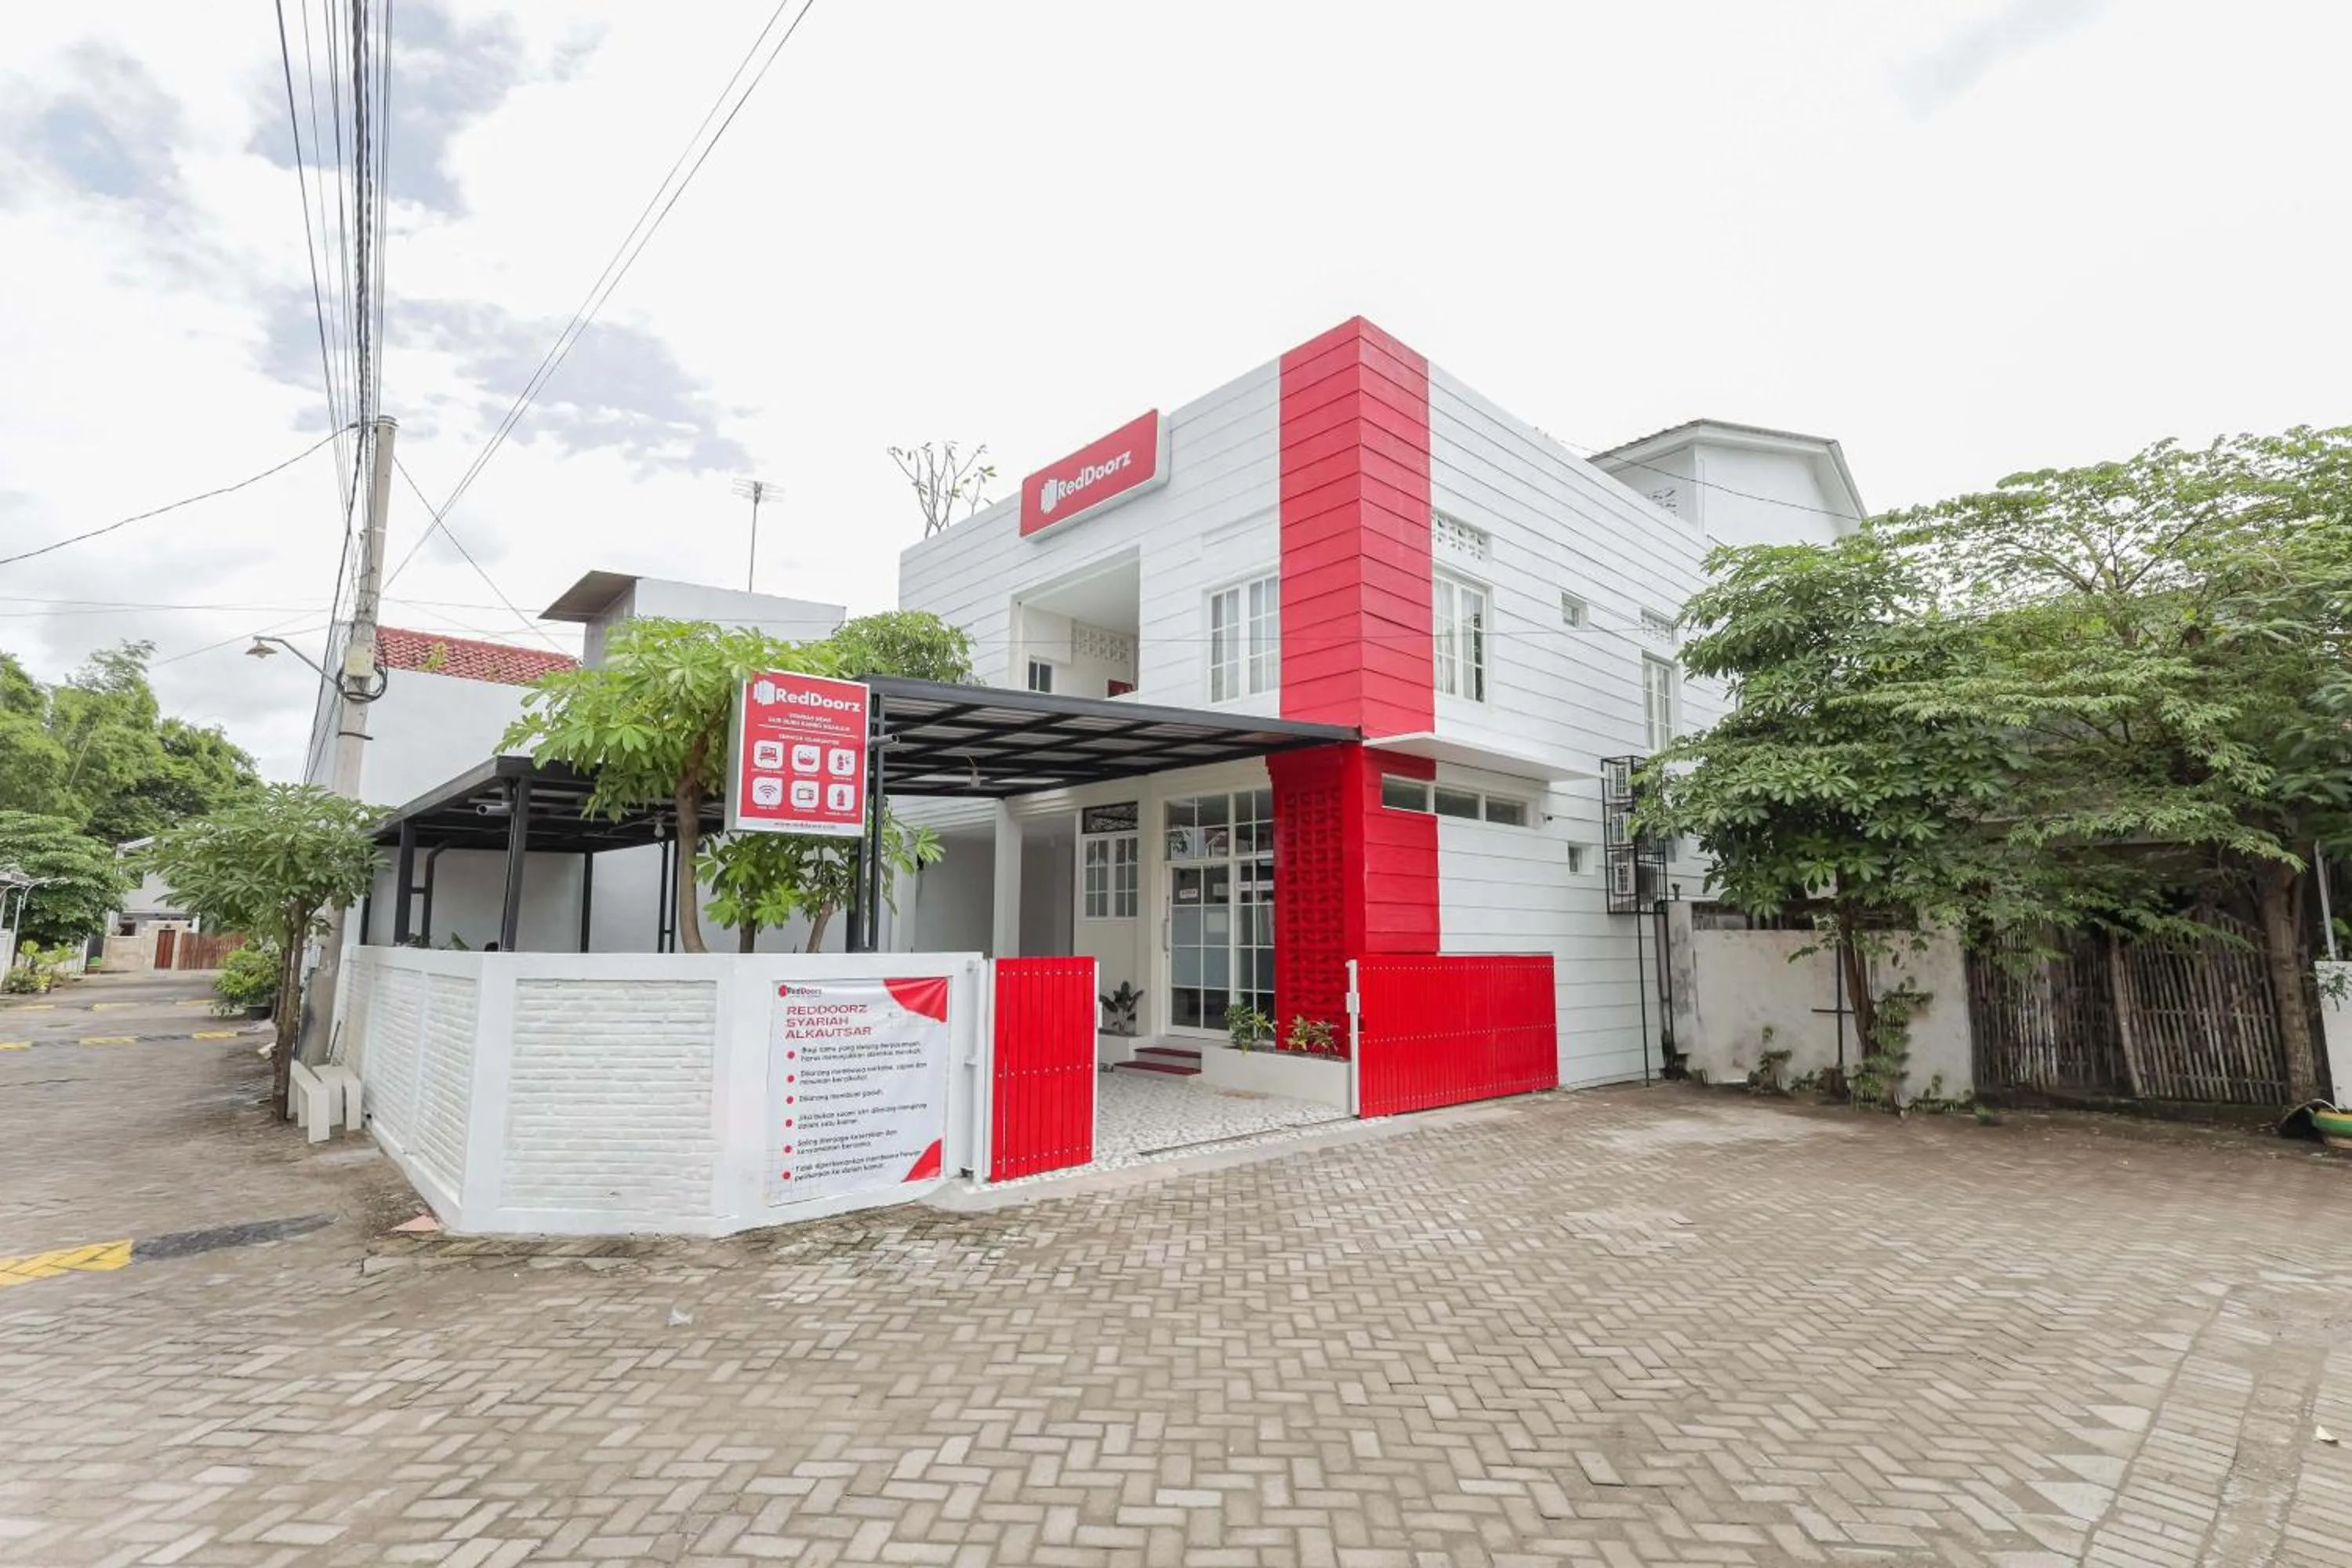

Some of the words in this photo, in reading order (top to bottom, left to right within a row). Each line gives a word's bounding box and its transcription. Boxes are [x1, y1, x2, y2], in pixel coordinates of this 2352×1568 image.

[1058, 451, 1131, 500] RedDoorz
[775, 688, 861, 712] RedDoorz
[786, 1004, 868, 1015] REDDOORZ
[786, 1017, 848, 1028] SYARIAH
[786, 1026, 872, 1039] ALKAUTSAR
